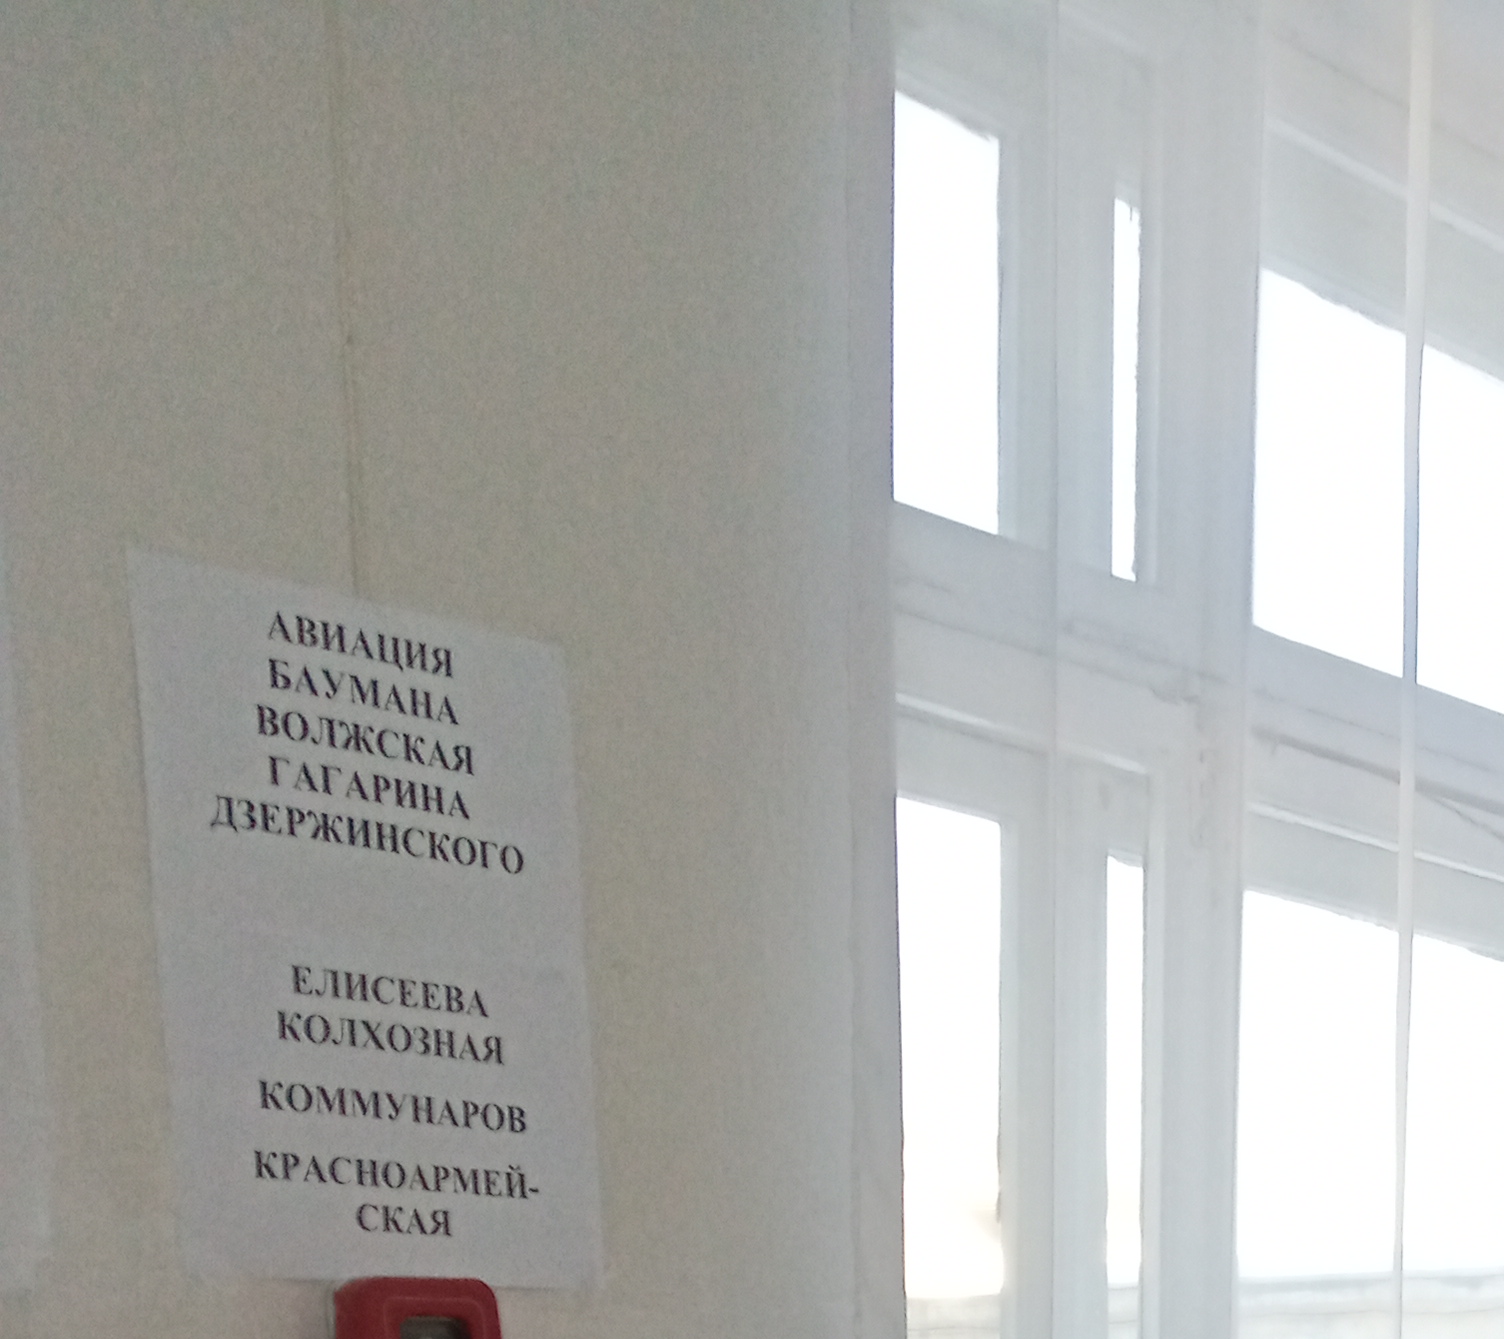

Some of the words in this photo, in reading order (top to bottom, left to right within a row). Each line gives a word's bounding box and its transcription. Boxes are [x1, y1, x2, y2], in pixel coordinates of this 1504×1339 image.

[267, 610, 454, 679] АВИАЦИЯ
[267, 656, 460, 727] БАУМАНА
[255, 703, 476, 777] ВОЛЖСКАЯ
[267, 754, 471, 822] ГАГАРИНА
[208, 793, 526, 876] ДЗЕРЖИНСКОГО
[290, 963, 490, 1019] ЕЛИСЕЕВА
[276, 1009, 506, 1067] КОЛХОЗНАЯ
[257, 1078, 528, 1135] КОММУНАРОВ
[253, 1149, 541, 1211] КРАСНОАРМЕЙ-
[354, 1202, 453, 1238] СКАЯ
